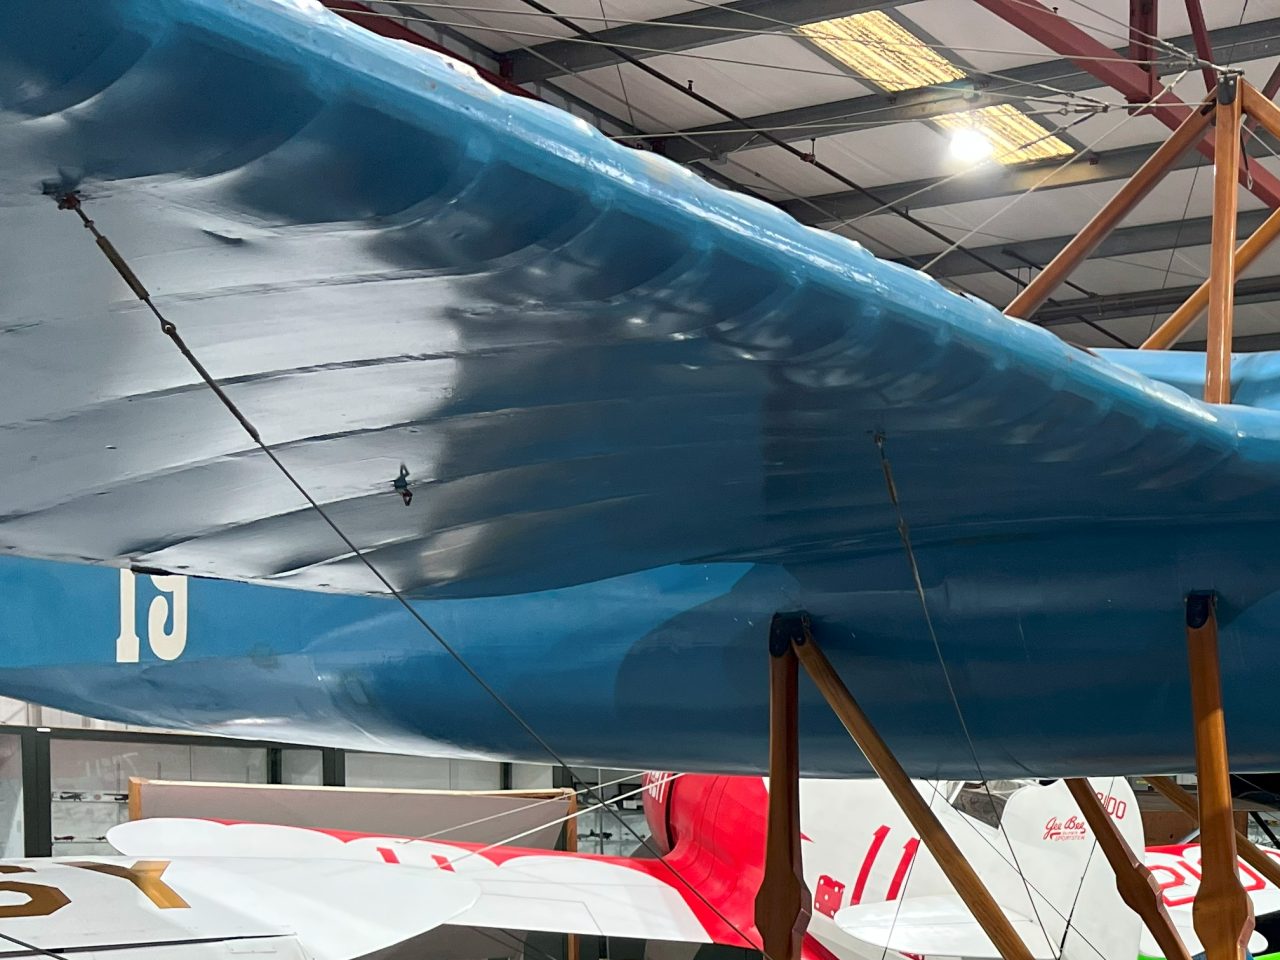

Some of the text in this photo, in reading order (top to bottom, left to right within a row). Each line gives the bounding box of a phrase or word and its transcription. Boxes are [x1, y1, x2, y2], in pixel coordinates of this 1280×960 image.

[116, 568, 188, 662] 19
[1043, 815, 1086, 840] Gee Bee
